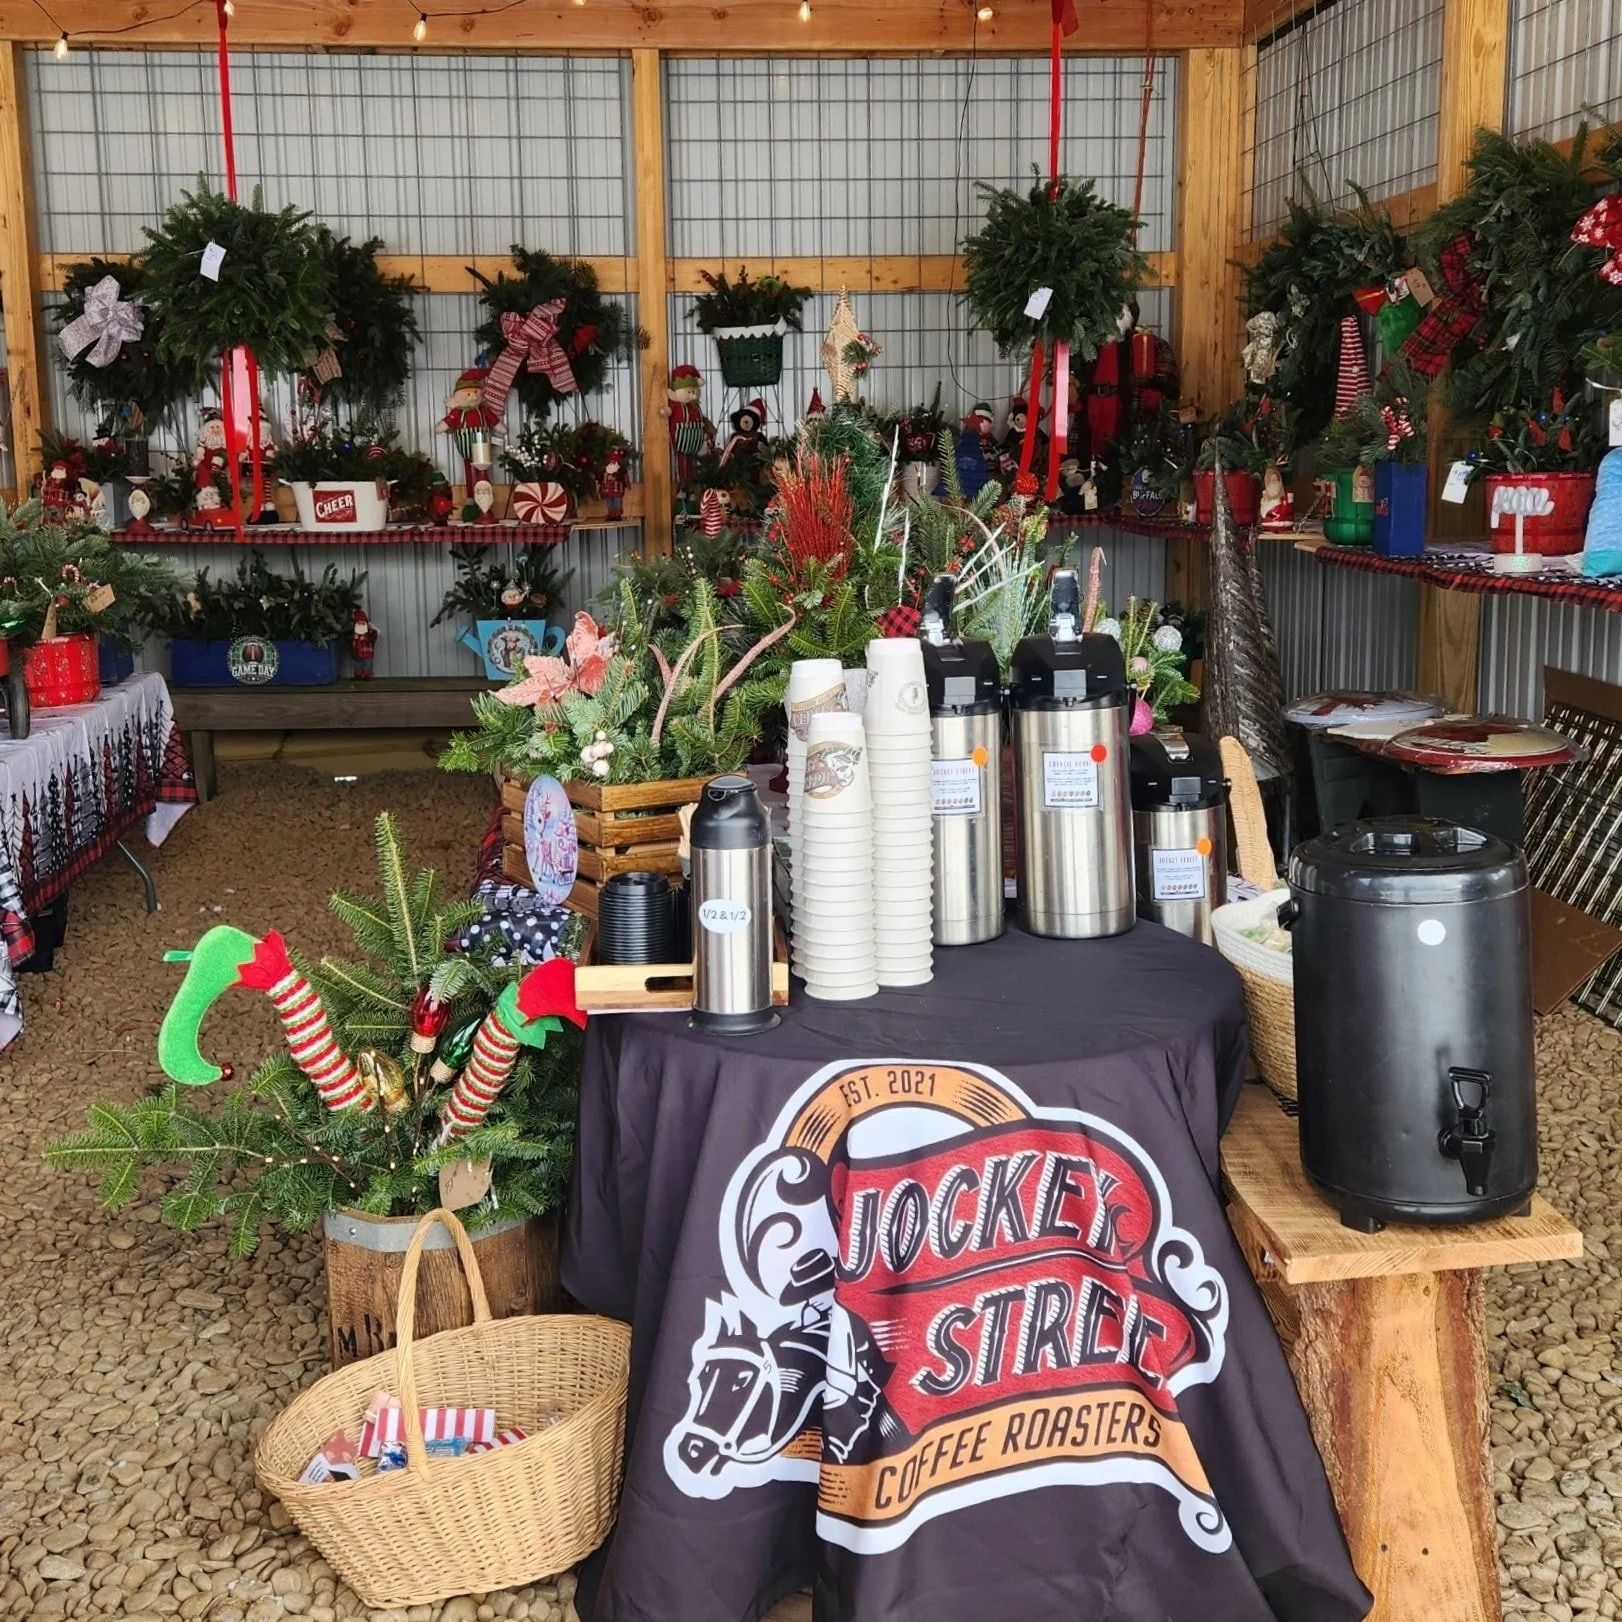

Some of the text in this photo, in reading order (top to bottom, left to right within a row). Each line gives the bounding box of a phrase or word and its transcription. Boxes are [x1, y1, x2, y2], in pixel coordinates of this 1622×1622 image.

[315, 495, 354, 518] CHEER
[231, 664, 275, 678] GAME DAY
[839, 1069, 936, 1108] EST. 2021
[838, 1150, 1123, 1282] JOCKEY
[908, 1274, 1167, 1396] STREE
[875, 1400, 1161, 1509] COFFEE ROASTERS
